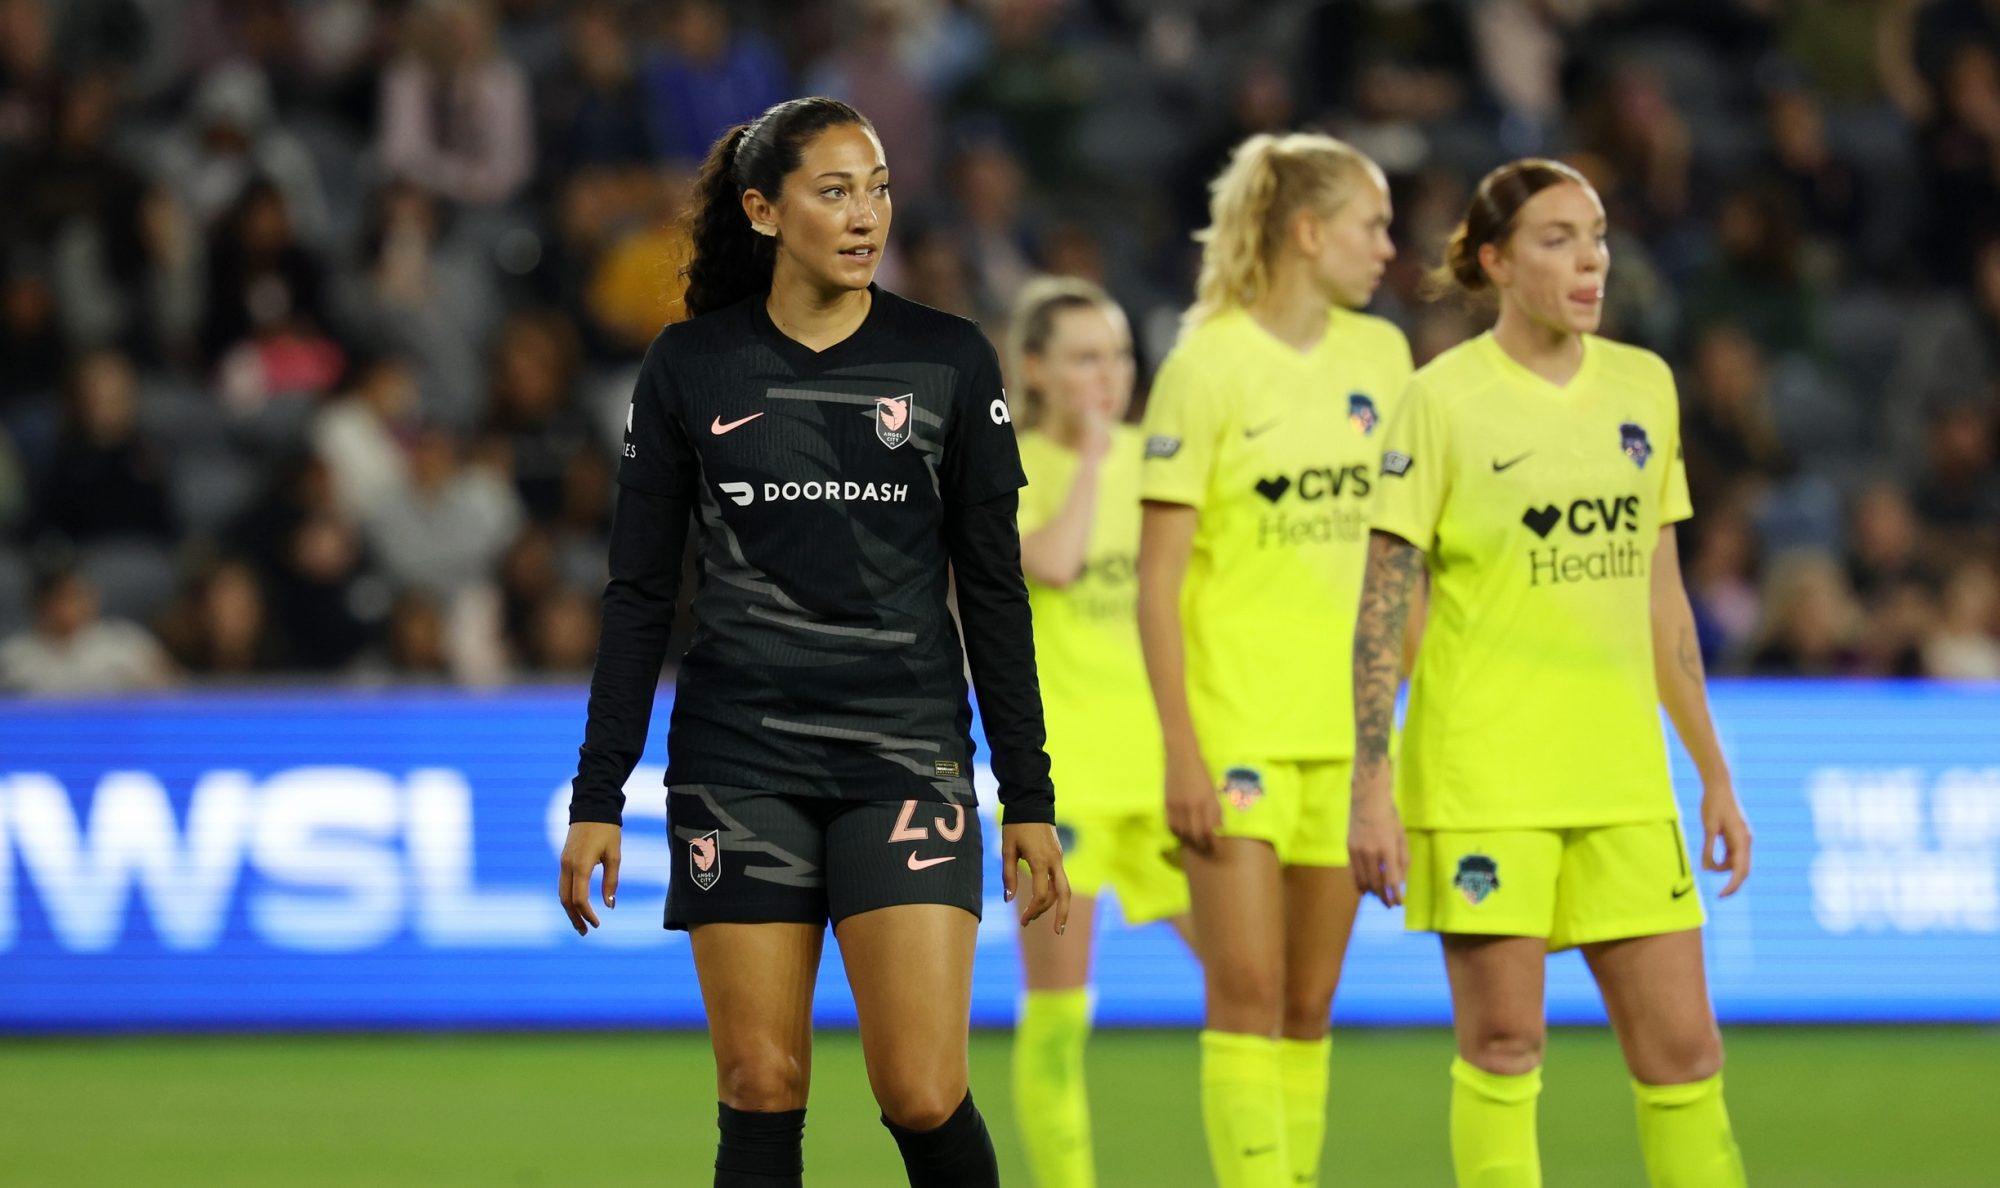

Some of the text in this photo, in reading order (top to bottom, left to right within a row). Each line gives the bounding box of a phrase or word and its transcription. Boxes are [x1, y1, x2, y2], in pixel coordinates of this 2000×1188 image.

[764, 481, 909, 502] DOORDASH
[1298, 464, 1370, 501] CVS
[1567, 495, 1640, 536] CVS
[1529, 540, 1645, 586] Health
